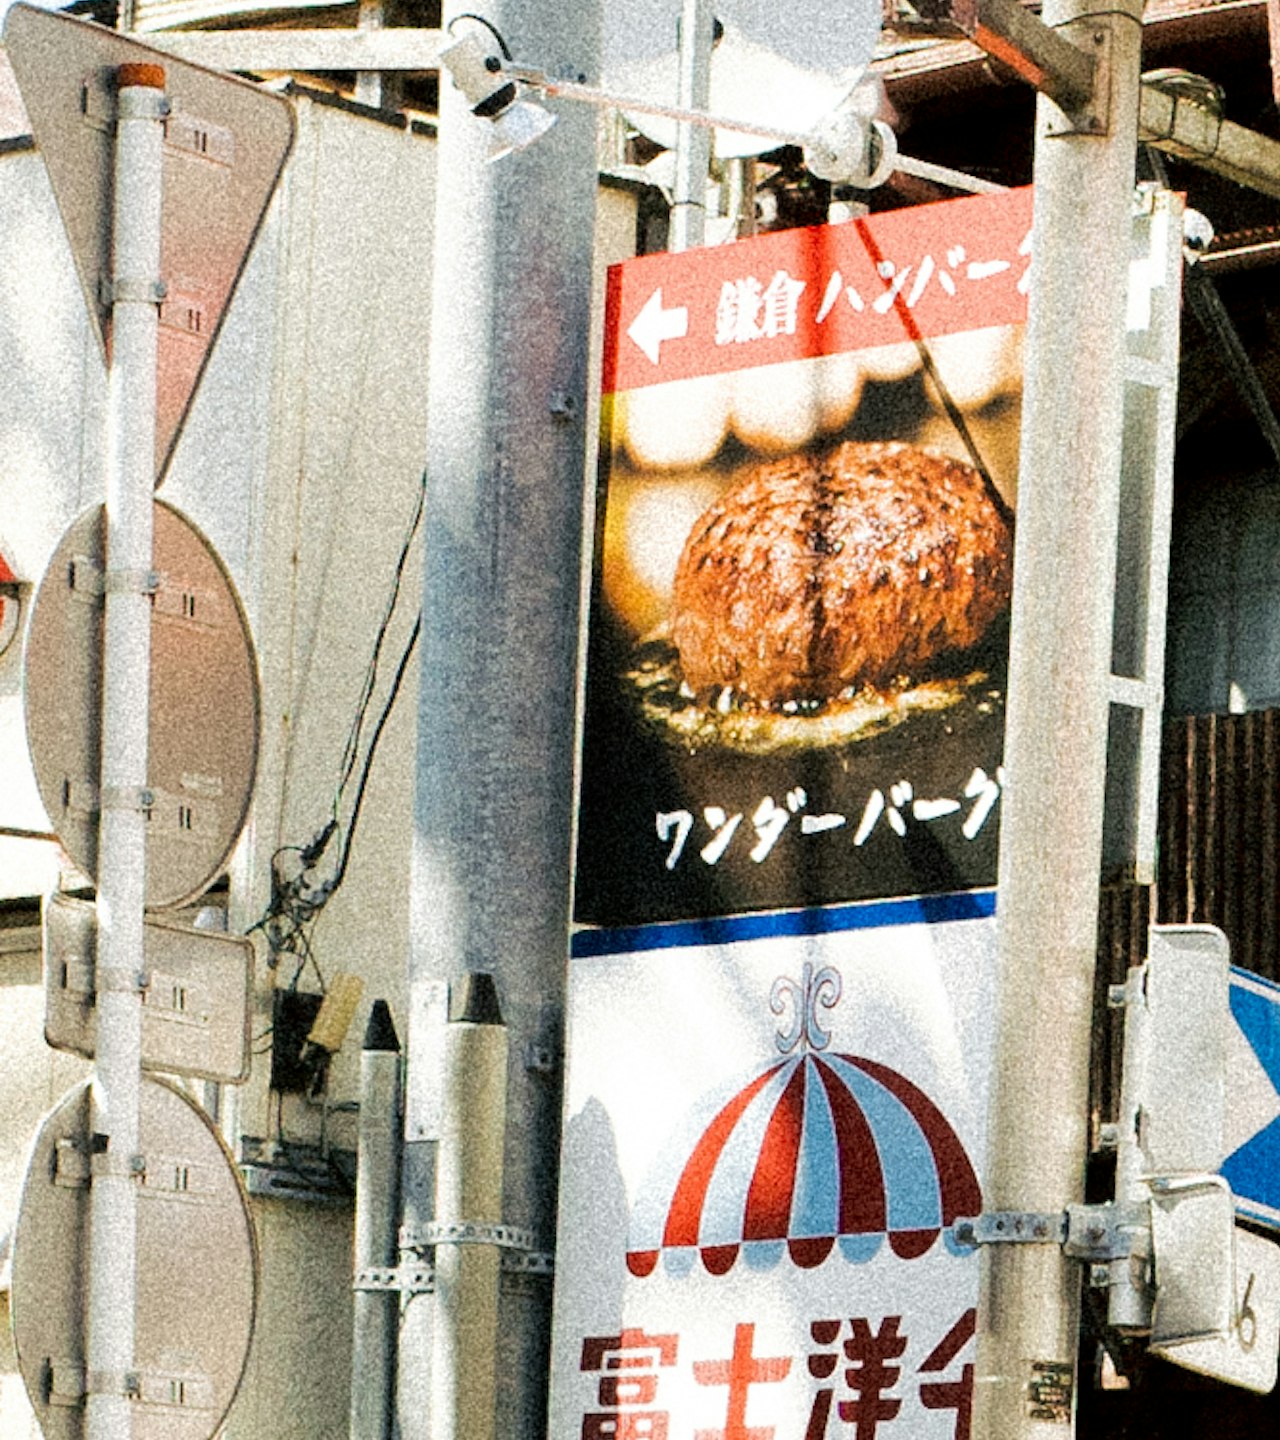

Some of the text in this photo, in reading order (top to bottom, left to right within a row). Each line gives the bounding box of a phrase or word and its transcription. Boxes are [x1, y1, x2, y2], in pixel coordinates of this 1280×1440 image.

[714, 228, 1032, 345] 鎌倉ハンバー
[655, 766, 1005, 871] ワンダーバーグ
